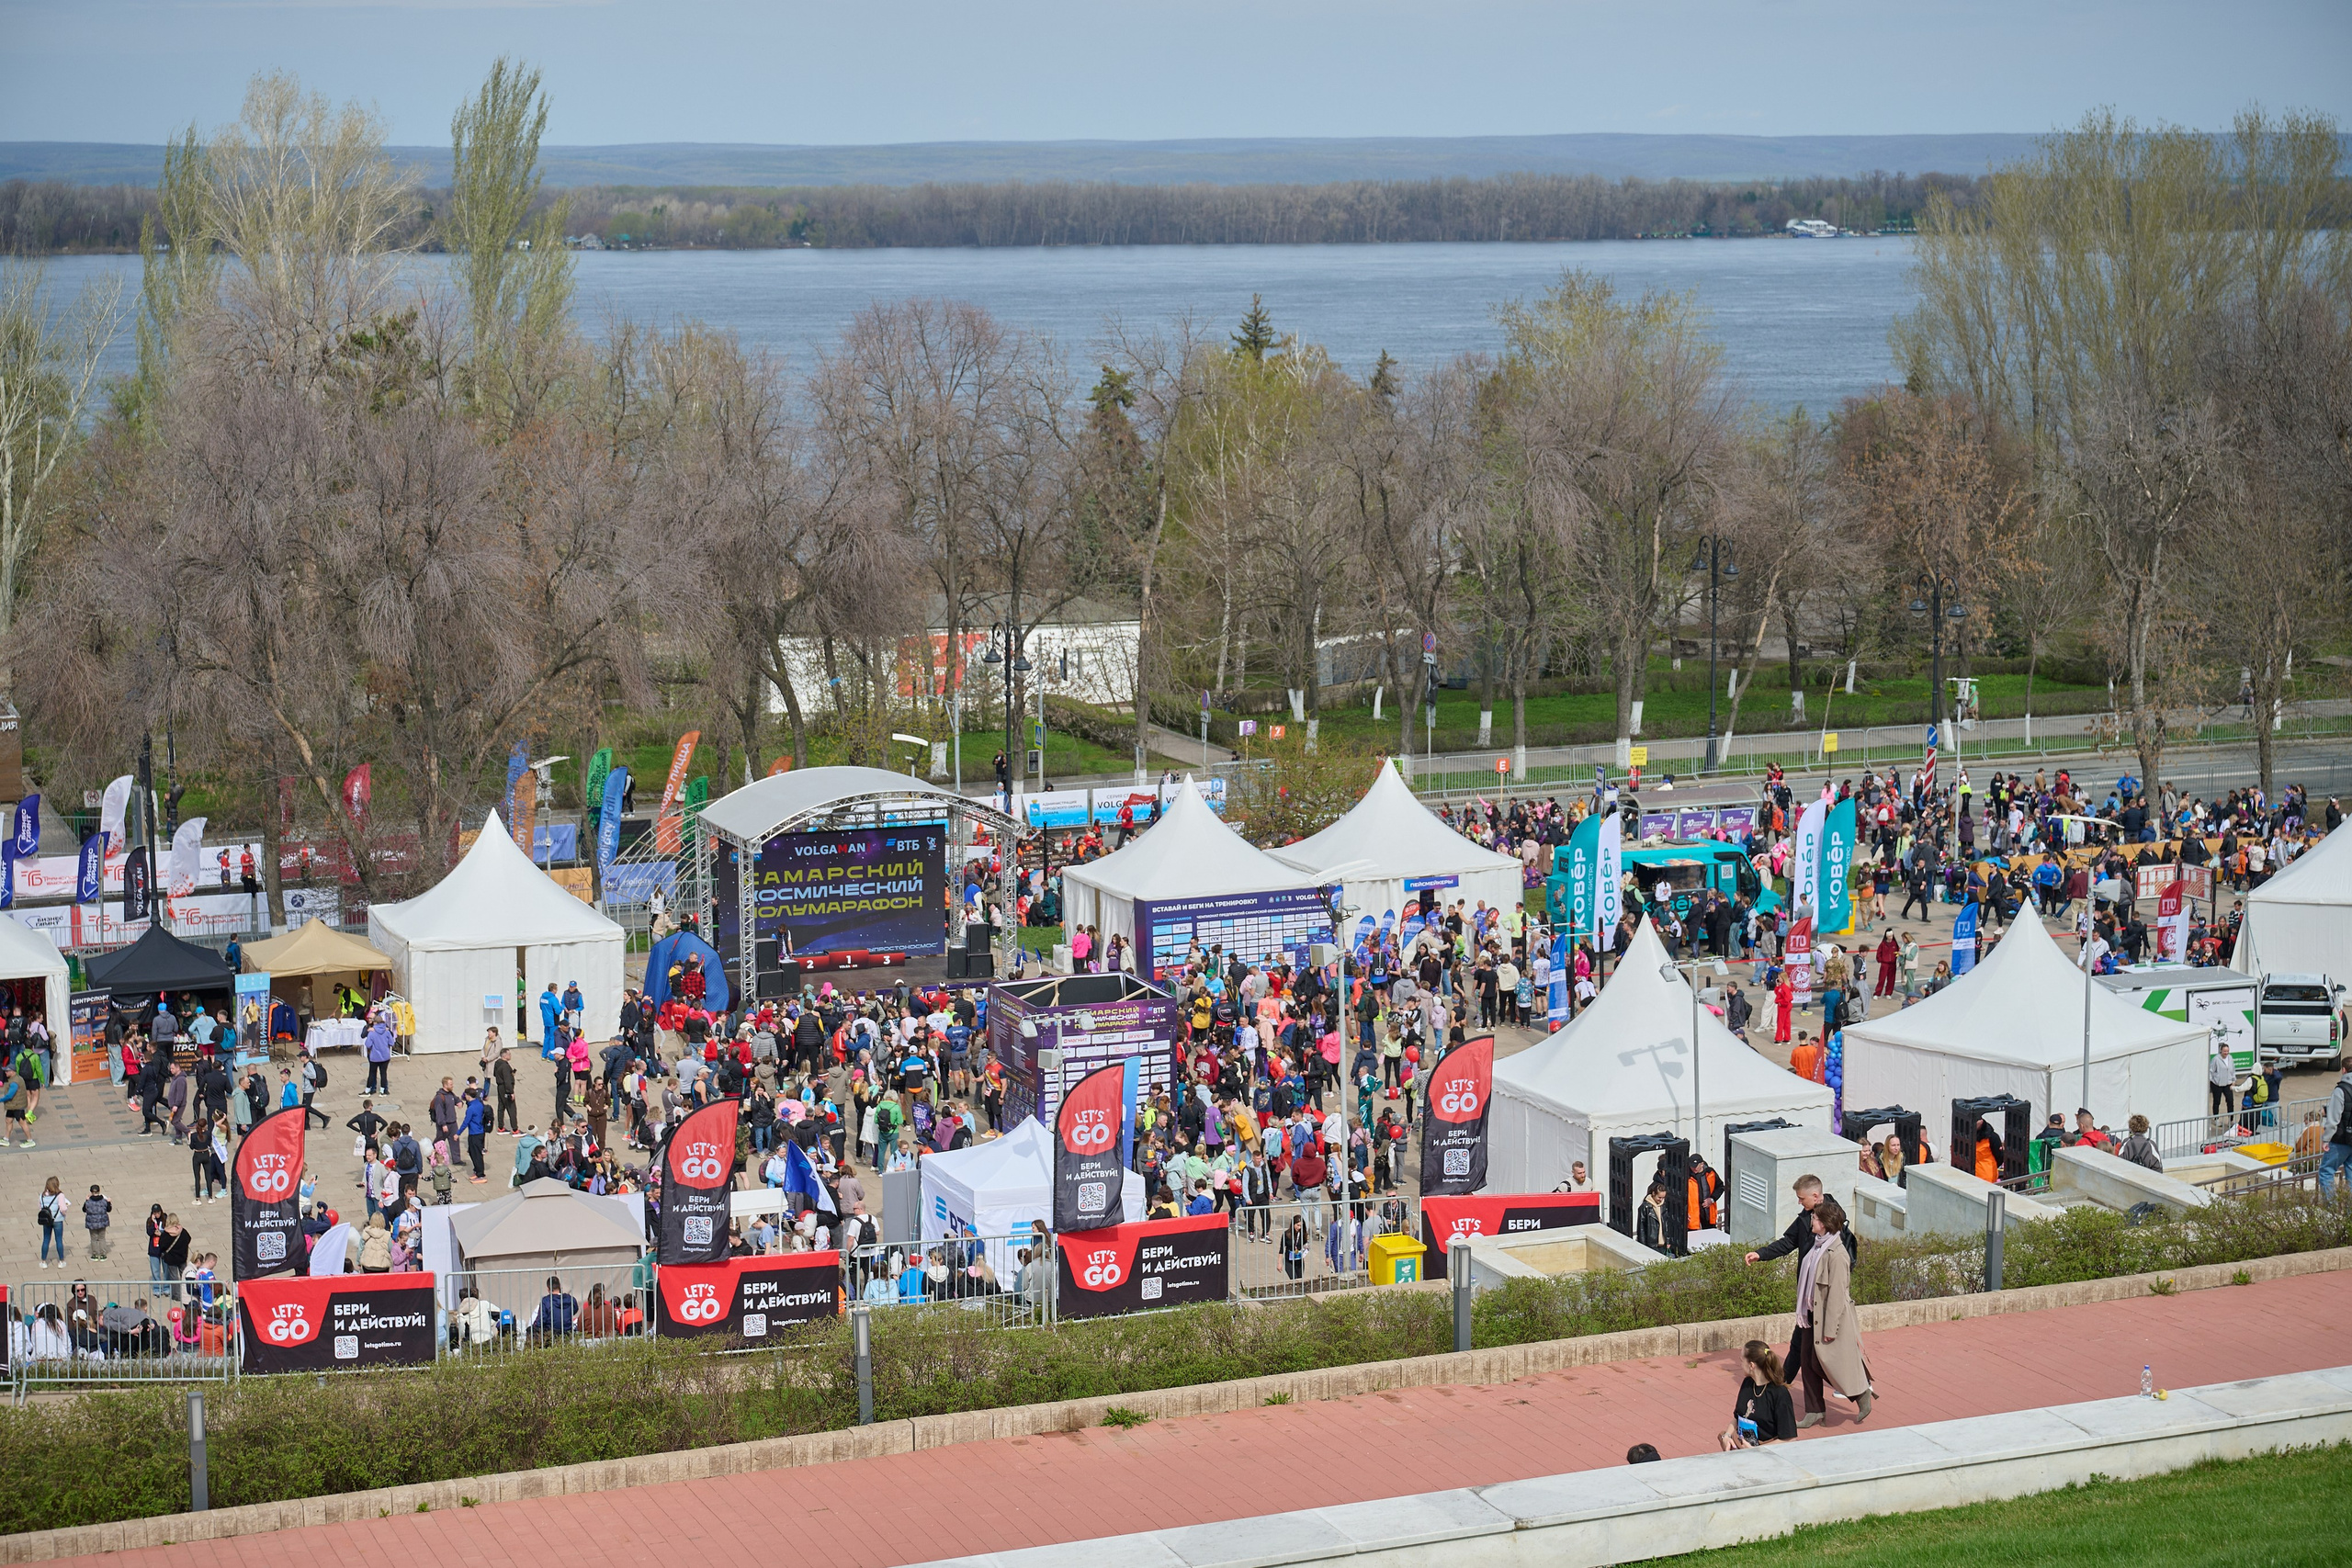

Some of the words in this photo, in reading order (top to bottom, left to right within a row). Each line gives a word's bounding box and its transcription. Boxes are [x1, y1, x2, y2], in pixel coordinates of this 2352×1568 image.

[897, 839, 920, 852] ВТБ
[1409, 879, 1453, 887] ПЕЙСМЕЙКЕРЫ
[1152, 904, 1182, 913] ВСТАВАЙ
[807, 960, 814, 968] 2
[845, 955, 852, 964] 1
[884, 955, 891, 964] 3
[72, 994, 109, 1005] ЦЕНТРСПОРТ
[1153, 1006, 1166, 1014] ВТБ
[259, 990, 268, 1055] ДВИЖЕНИЕ
[1445, 1078, 1475, 1092] LET'S
[1441, 1093, 1477, 1113] GO
[1075, 1110, 1104, 1124] LET'S
[1071, 1123, 1110, 1146] GO
[1448, 1129, 1467, 1137] БЕРИ
[686, 1142, 718, 1156] LET'S
[254, 1154, 287, 1169] LET'S
[682, 1157, 722, 1179] GO
[1080, 1162, 1101, 1170] БЕРИ
[250, 1169, 289, 1192] GO
[1073, 1169, 1118, 1181] ДЕЙСТВУЙ!
[681, 1201, 725, 1213] ДЕЙСТВУЙ!
[259, 1211, 279, 1219] БЕРИ
[253, 1218, 296, 1229] ДЕЙСТВУЙ!
[1452, 1218, 1481, 1232] LET'S
[1508, 1218, 1542, 1230] БЕРИ
[1088, 1249, 1117, 1265] LET'S
[1142, 1246, 1173, 1259] БЕРИ
[1142, 1262, 1151, 1273] И
[1154, 1251, 1221, 1273] ДЕЙСТВУЙ!
[1084, 1264, 1121, 1286] GO
[684, 1283, 715, 1298] LET'S
[744, 1281, 777, 1295] БЕРИ
[744, 1299, 753, 1310] И
[757, 1290, 831, 1311] ДЕЙСТВУЙ!
[272, 1303, 305, 1319] LET'S
[334, 1303, 369, 1316] БЕРИ
[680, 1298, 720, 1321] GO
[334, 1319, 345, 1331] И
[348, 1312, 426, 1332] ДЕЙСТВУЙ!
[268, 1318, 311, 1341] GO
